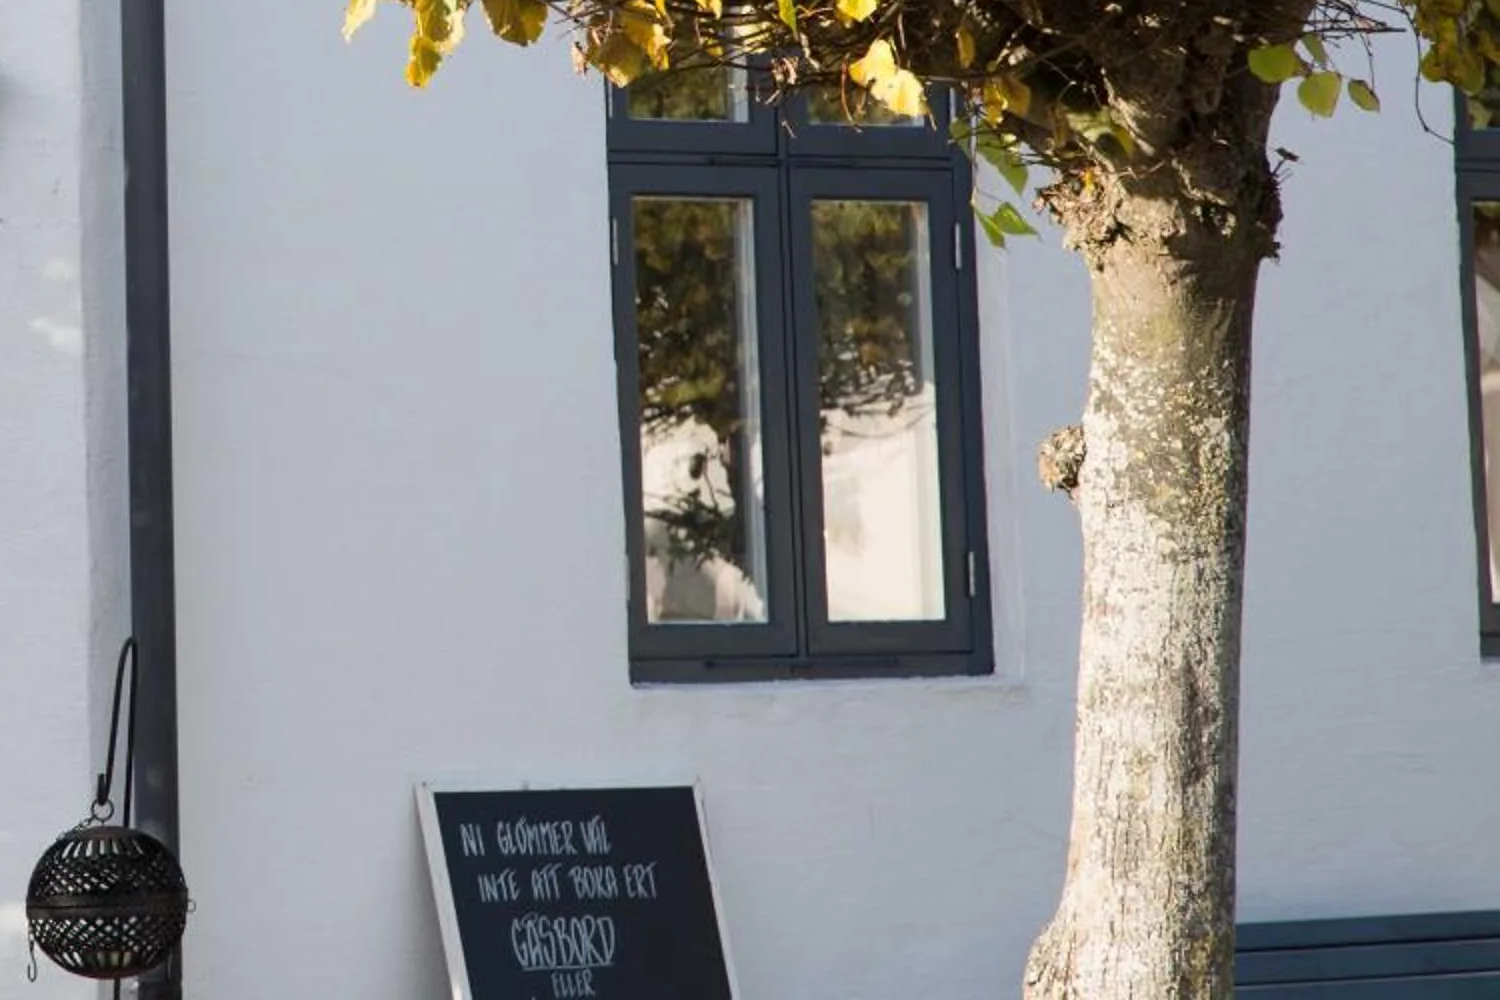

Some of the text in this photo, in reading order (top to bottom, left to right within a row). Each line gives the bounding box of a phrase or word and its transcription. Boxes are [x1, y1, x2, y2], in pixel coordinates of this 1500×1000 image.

[460, 822, 485, 856] NI
[477, 860, 659, 903] INTE ATT BOKA ERT
[551, 968, 596, 998] ELLER
